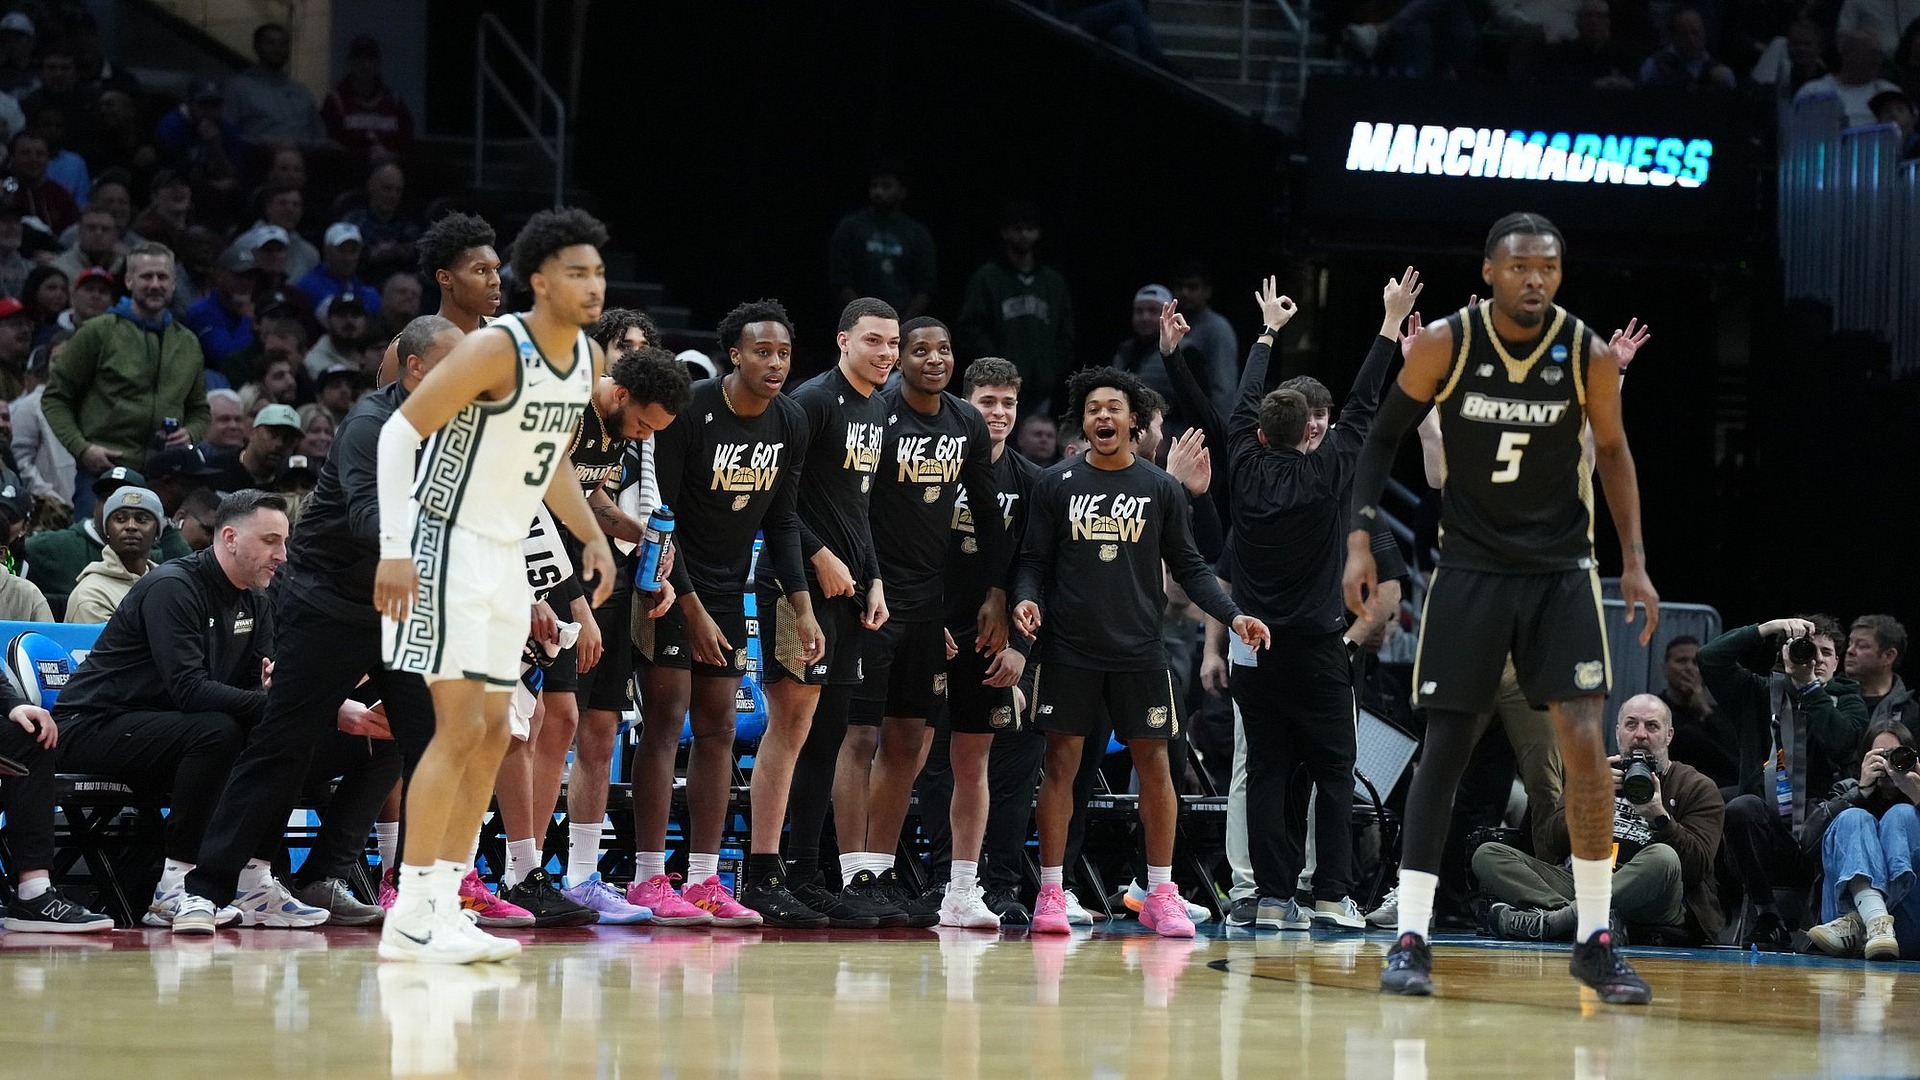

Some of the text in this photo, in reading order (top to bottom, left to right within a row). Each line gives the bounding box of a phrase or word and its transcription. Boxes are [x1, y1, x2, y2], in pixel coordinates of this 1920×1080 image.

[1461, 394, 1568, 425] BRYANT
[846, 422, 883, 453] WE GOT
[897, 434, 967, 463] WE GOT
[524, 442, 556, 487] 3
[713, 442, 784, 471] WE GOT
[1491, 431, 1531, 483] 5
[111, 466, 127, 480] S
[1069, 493, 1151, 523] WE GOT
[41, 899, 71, 920] N
